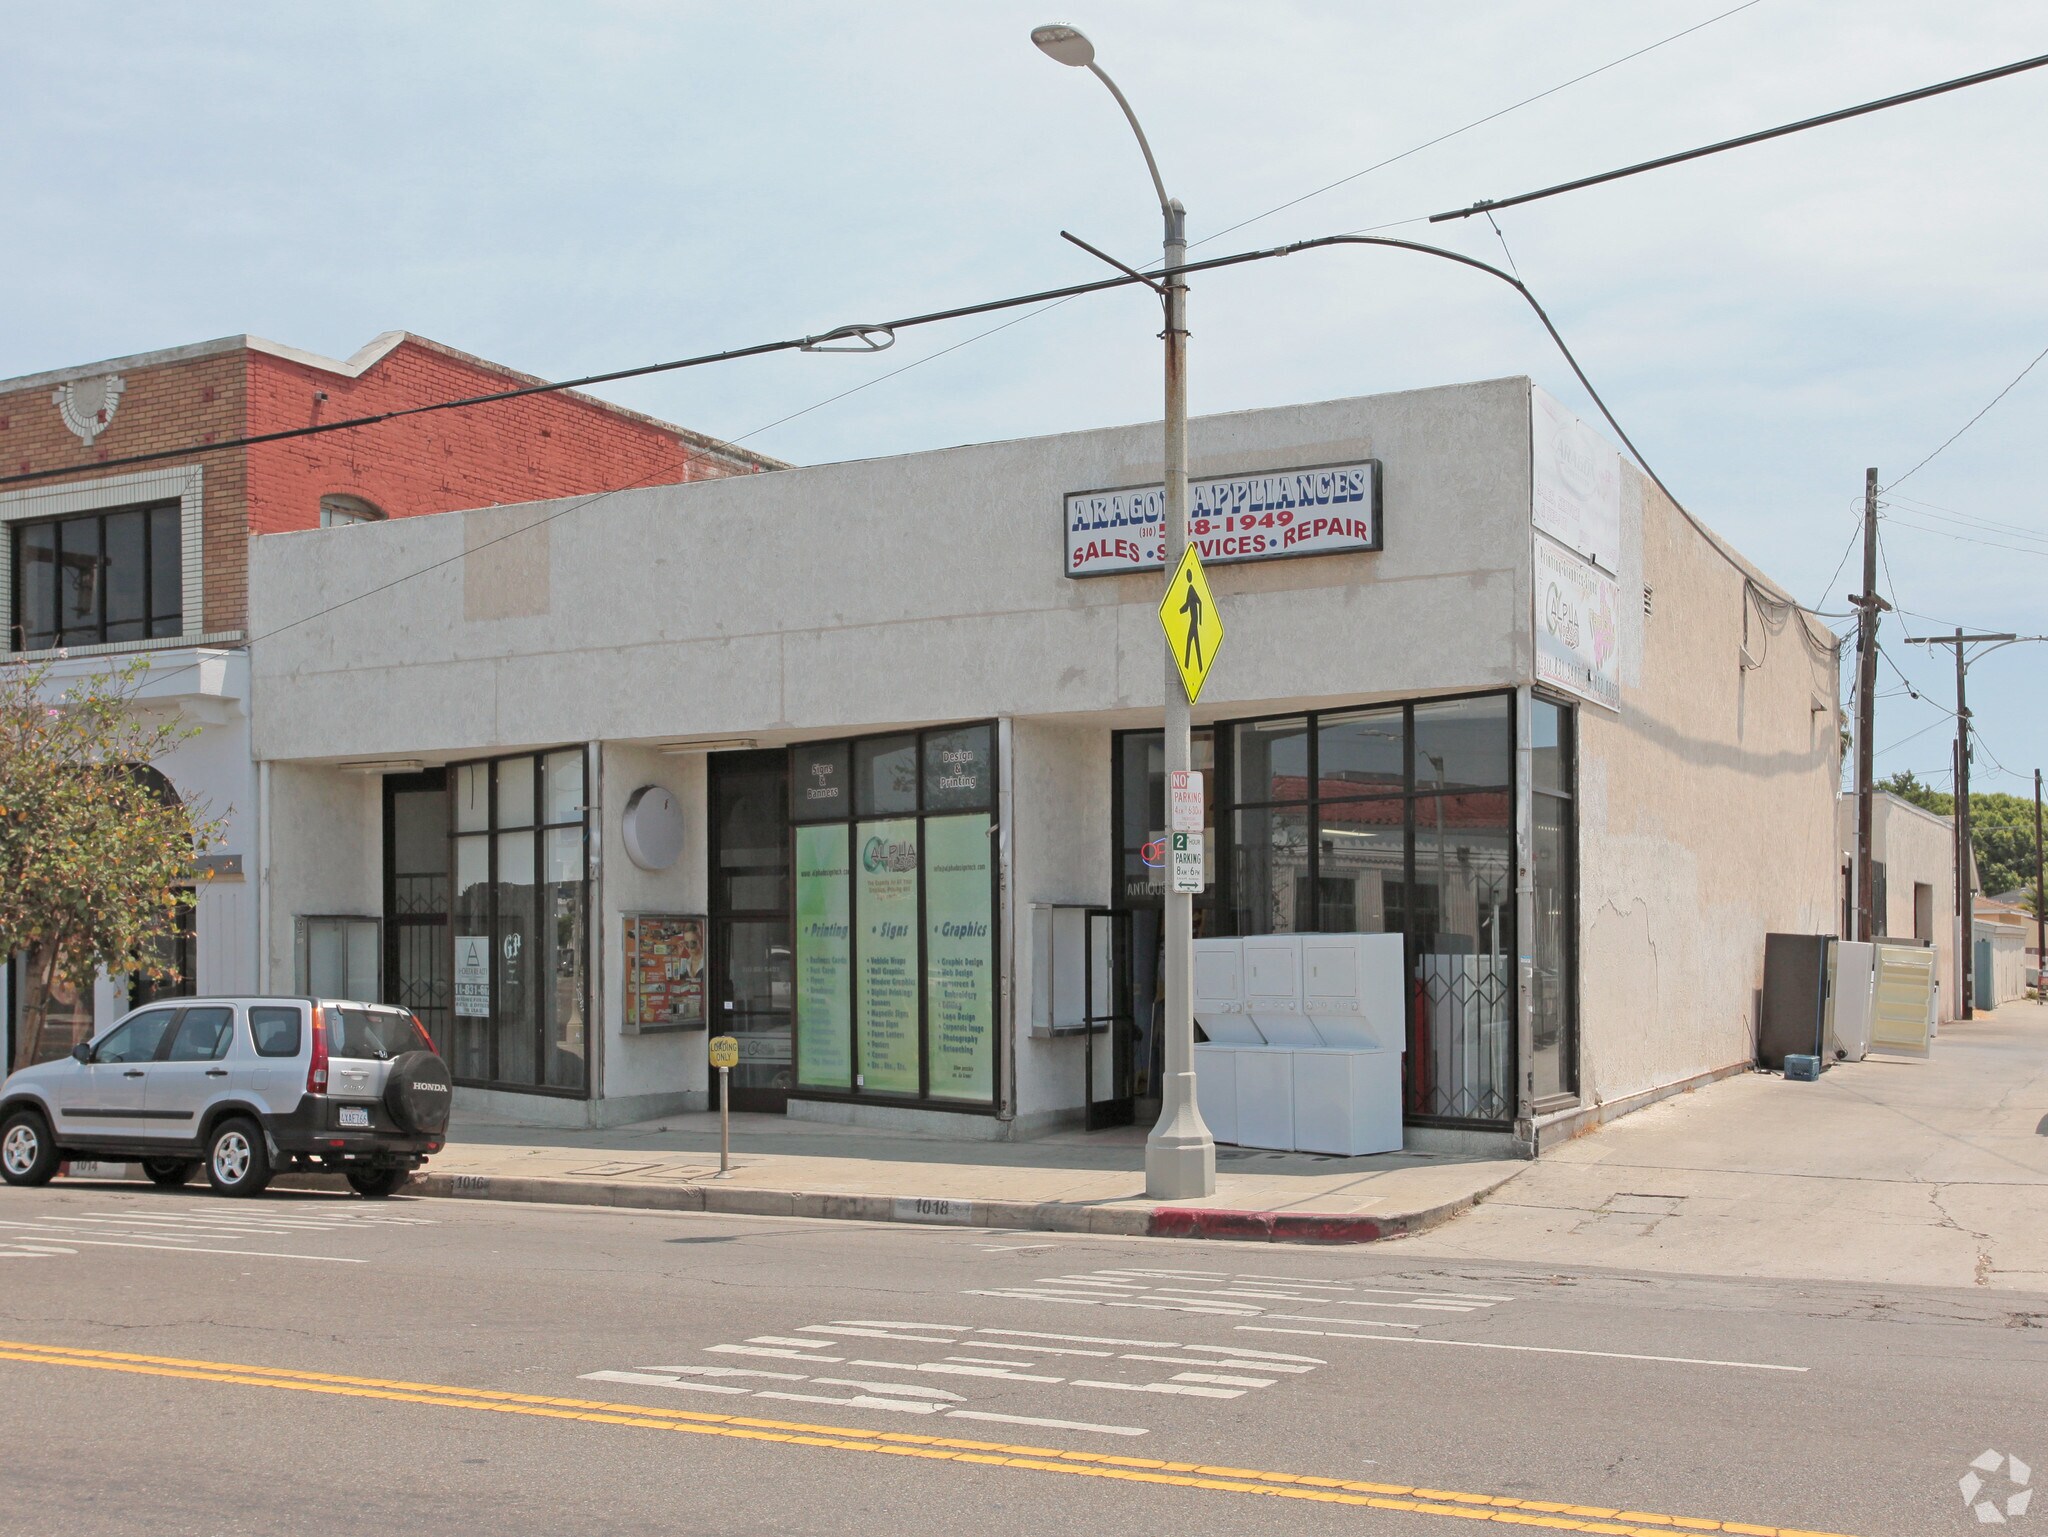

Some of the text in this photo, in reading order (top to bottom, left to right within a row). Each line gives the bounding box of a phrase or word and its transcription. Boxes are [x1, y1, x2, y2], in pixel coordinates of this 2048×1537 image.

[1072, 469, 1364, 531] ARAGO APPLIANCES
[1072, 517, 1368, 568] SALES SVICES REPAIR
[942, 750, 974, 763] Design
[811, 764, 833, 776] Signs
[953, 762, 962, 774] &
[939, 775, 977, 789] Printing
[1173, 774, 1187, 788] NO
[806, 787, 839, 800] Banners
[1174, 792, 1202, 803] PARKING
[1176, 835, 1184, 848] 2
[870, 840, 916, 860] ALPHA
[1141, 842, 1166, 861] OP
[1175, 853, 1202, 864] PARKING
[811, 923, 848, 940] Printing
[880, 922, 908, 939] Signs
[942, 921, 987, 940] Graphics
[942, 958, 983, 967] Graphic Design
[958, 1013, 976, 1022] Design
[943, 1035, 978, 1044] Photography
[711, 1042, 738, 1052] LOADING
[716, 1053, 732, 1062] ONLY
[412, 1082, 448, 1092] HONDA
[457, 1176, 485, 1189] 1016
[915, 1198, 949, 1215] 1018
